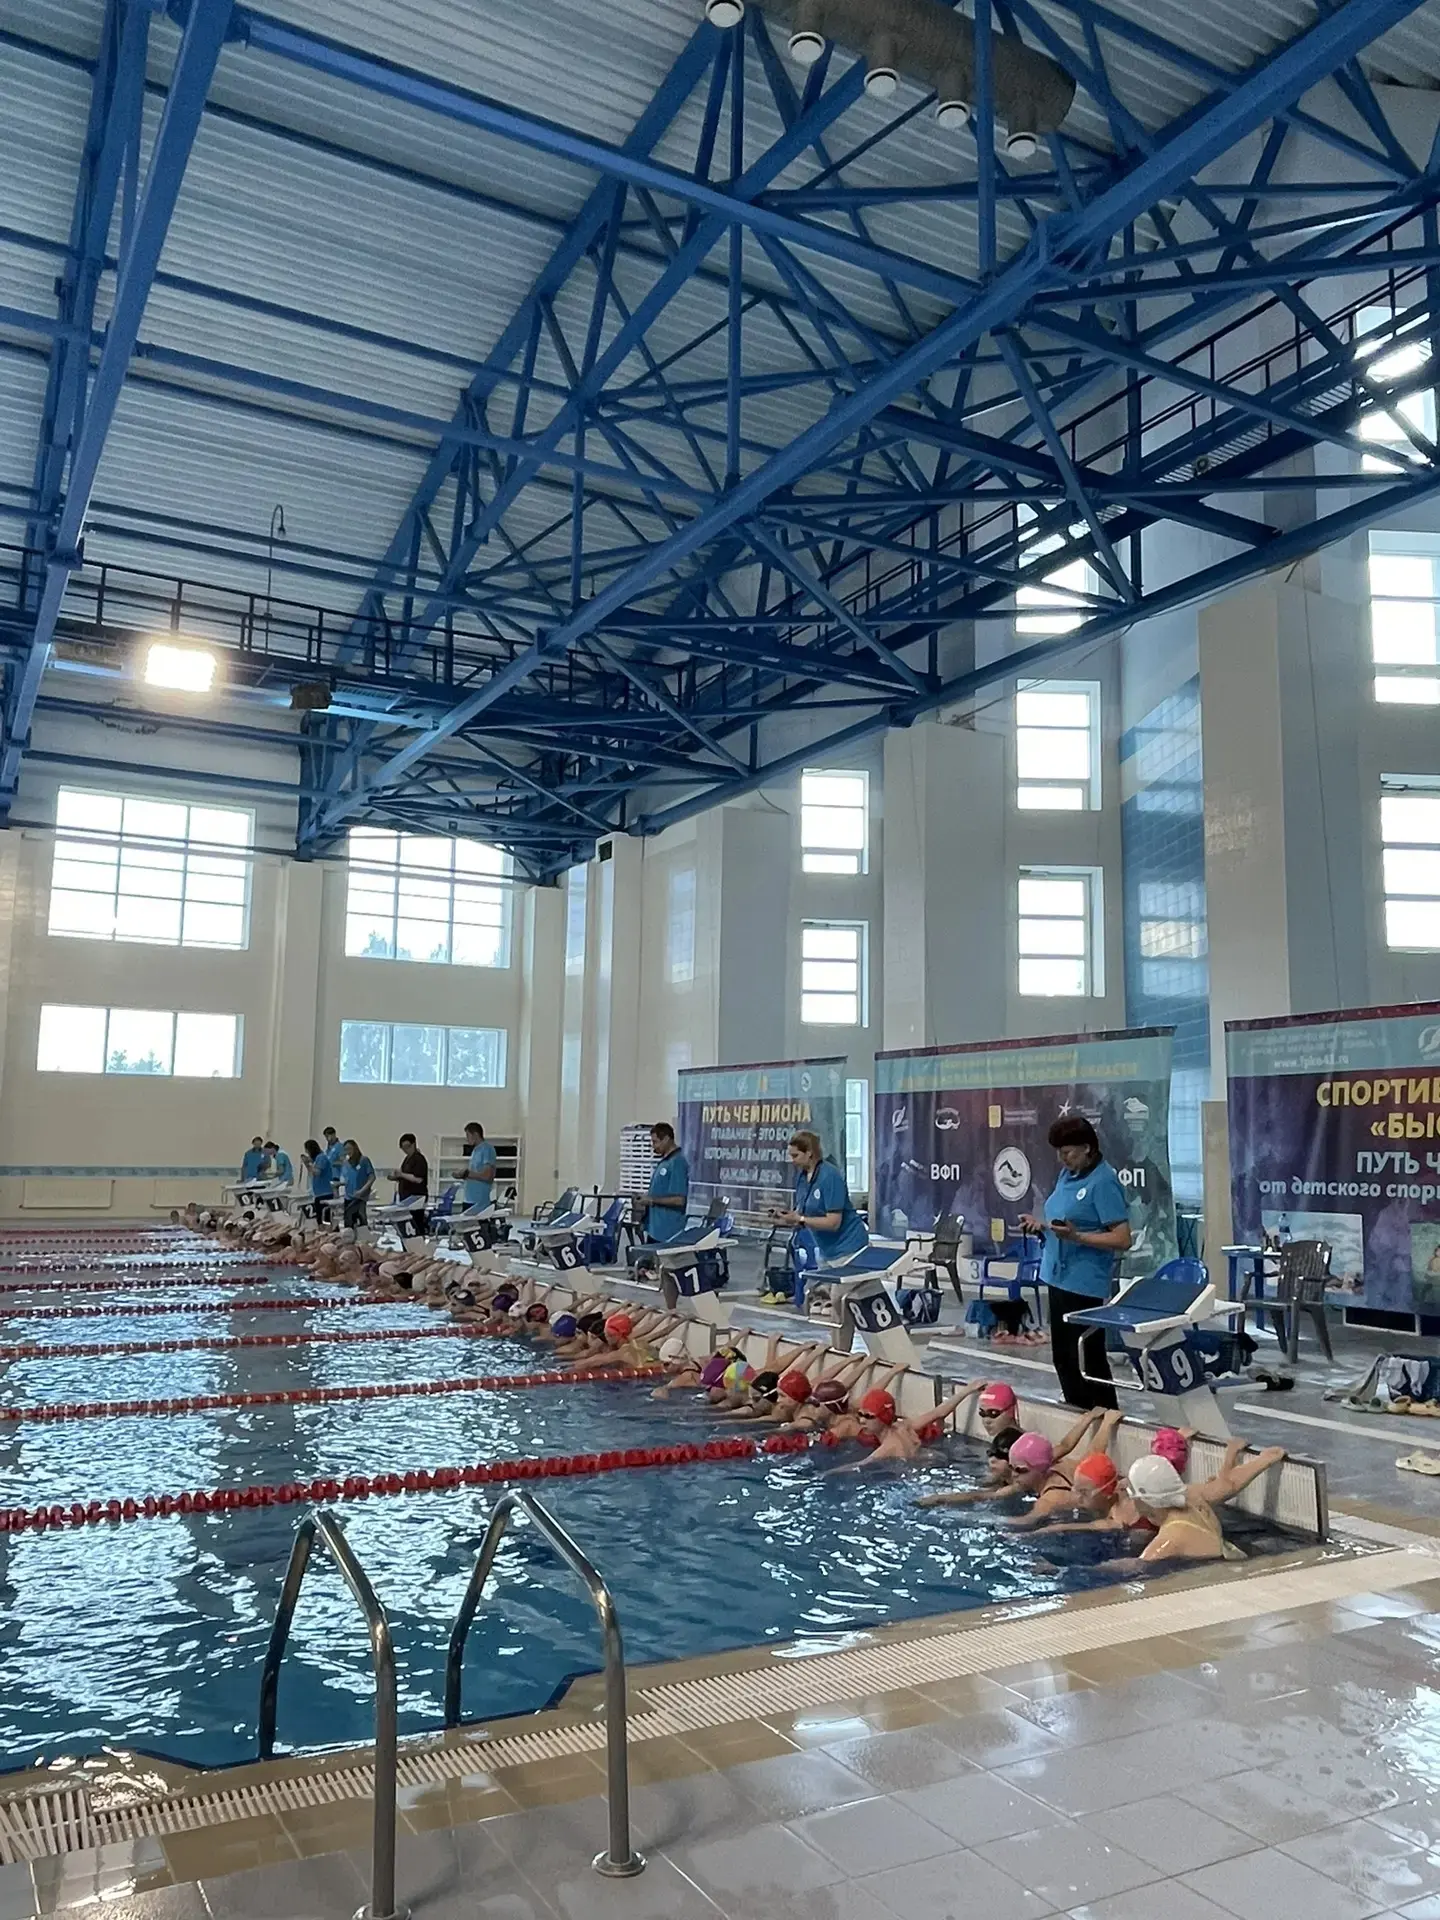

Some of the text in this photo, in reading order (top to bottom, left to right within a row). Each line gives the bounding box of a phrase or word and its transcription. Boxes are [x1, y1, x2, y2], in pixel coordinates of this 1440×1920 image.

[702, 1104, 812, 1123] ПУТЬ ЧЕМПИОНА
[1370, 1111, 1440, 1139] «БЫ
[930, 1163, 960, 1180] ВФП
[1356, 1151, 1420, 1174] ПУТЬ
[1259, 1179, 1287, 1194] от
[1291, 1175, 1381, 1197] детского
[271, 1198, 280, 1210] 1
[306, 1204, 317, 1218] 2
[406, 1223, 417, 1236] 4
[473, 1231, 485, 1249] 5
[561, 1246, 576, 1267] 6
[970, 1260, 979, 1279] 3
[684, 1267, 700, 1293] 7
[871, 1297, 891, 1328] 8
[1171, 1348, 1193, 1388] 9
